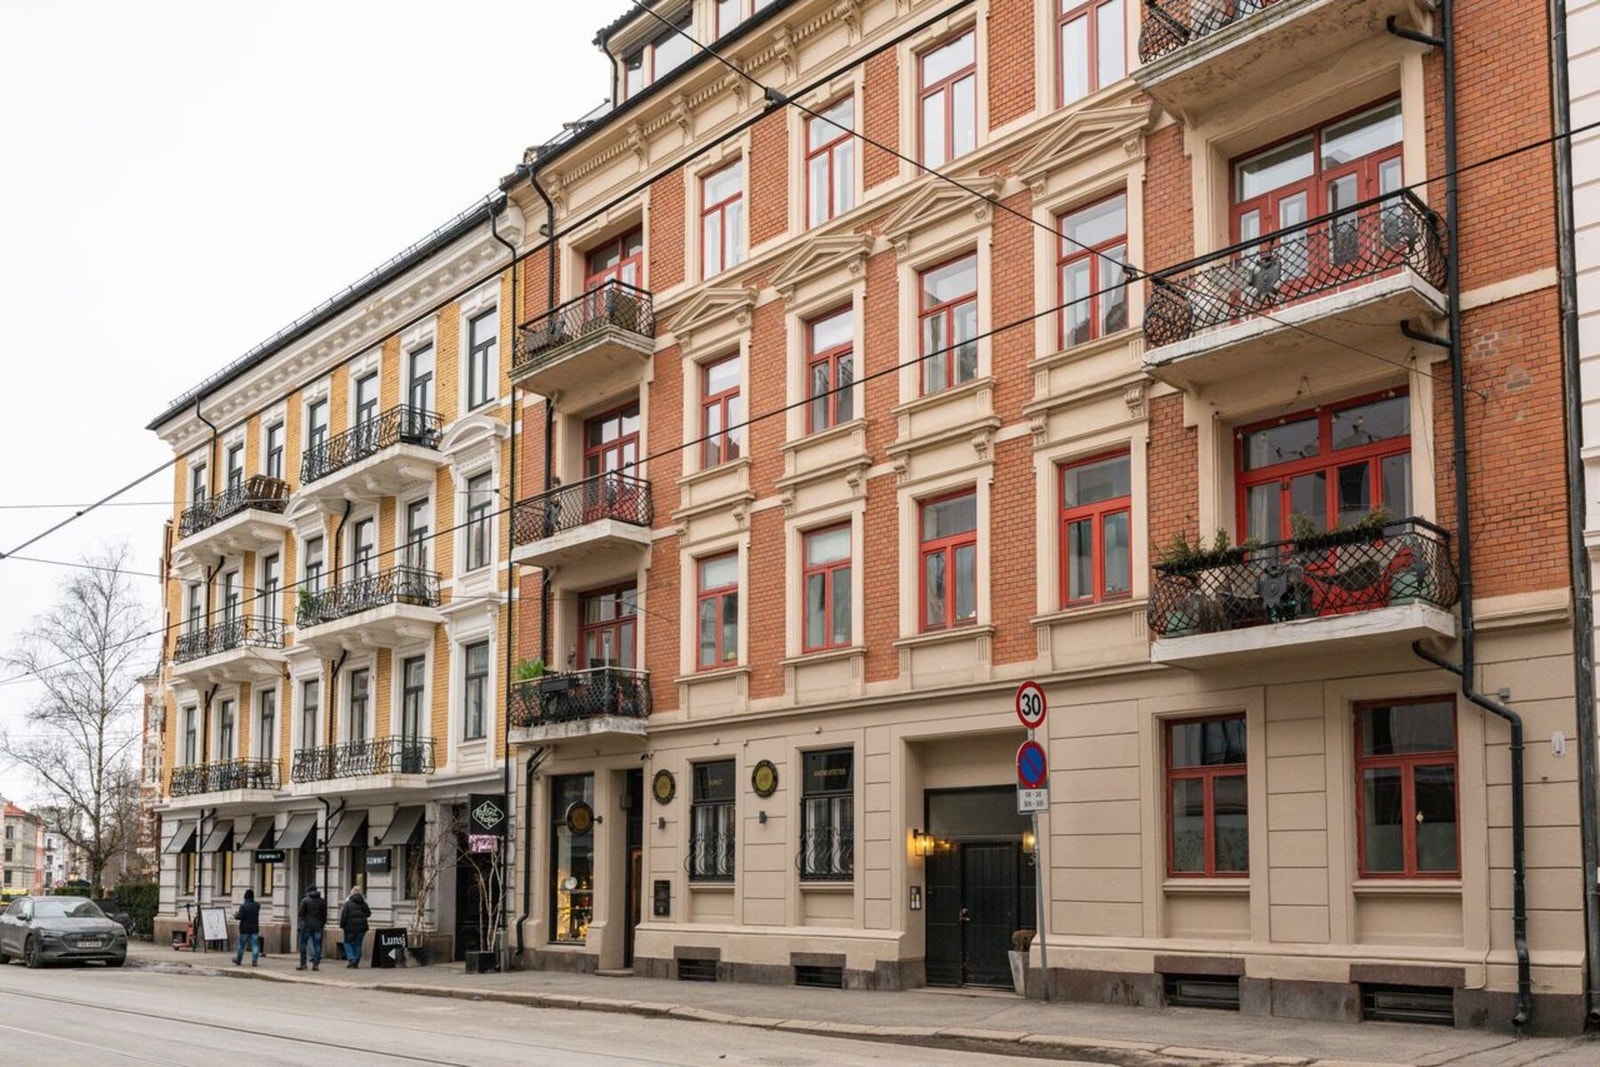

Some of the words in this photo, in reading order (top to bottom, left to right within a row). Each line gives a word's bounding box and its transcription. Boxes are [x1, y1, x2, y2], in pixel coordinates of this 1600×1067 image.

[1022, 693, 1041, 716] 30
[366, 856, 388, 865] SUMMIT
[381, 933, 406, 947] Lunsj
